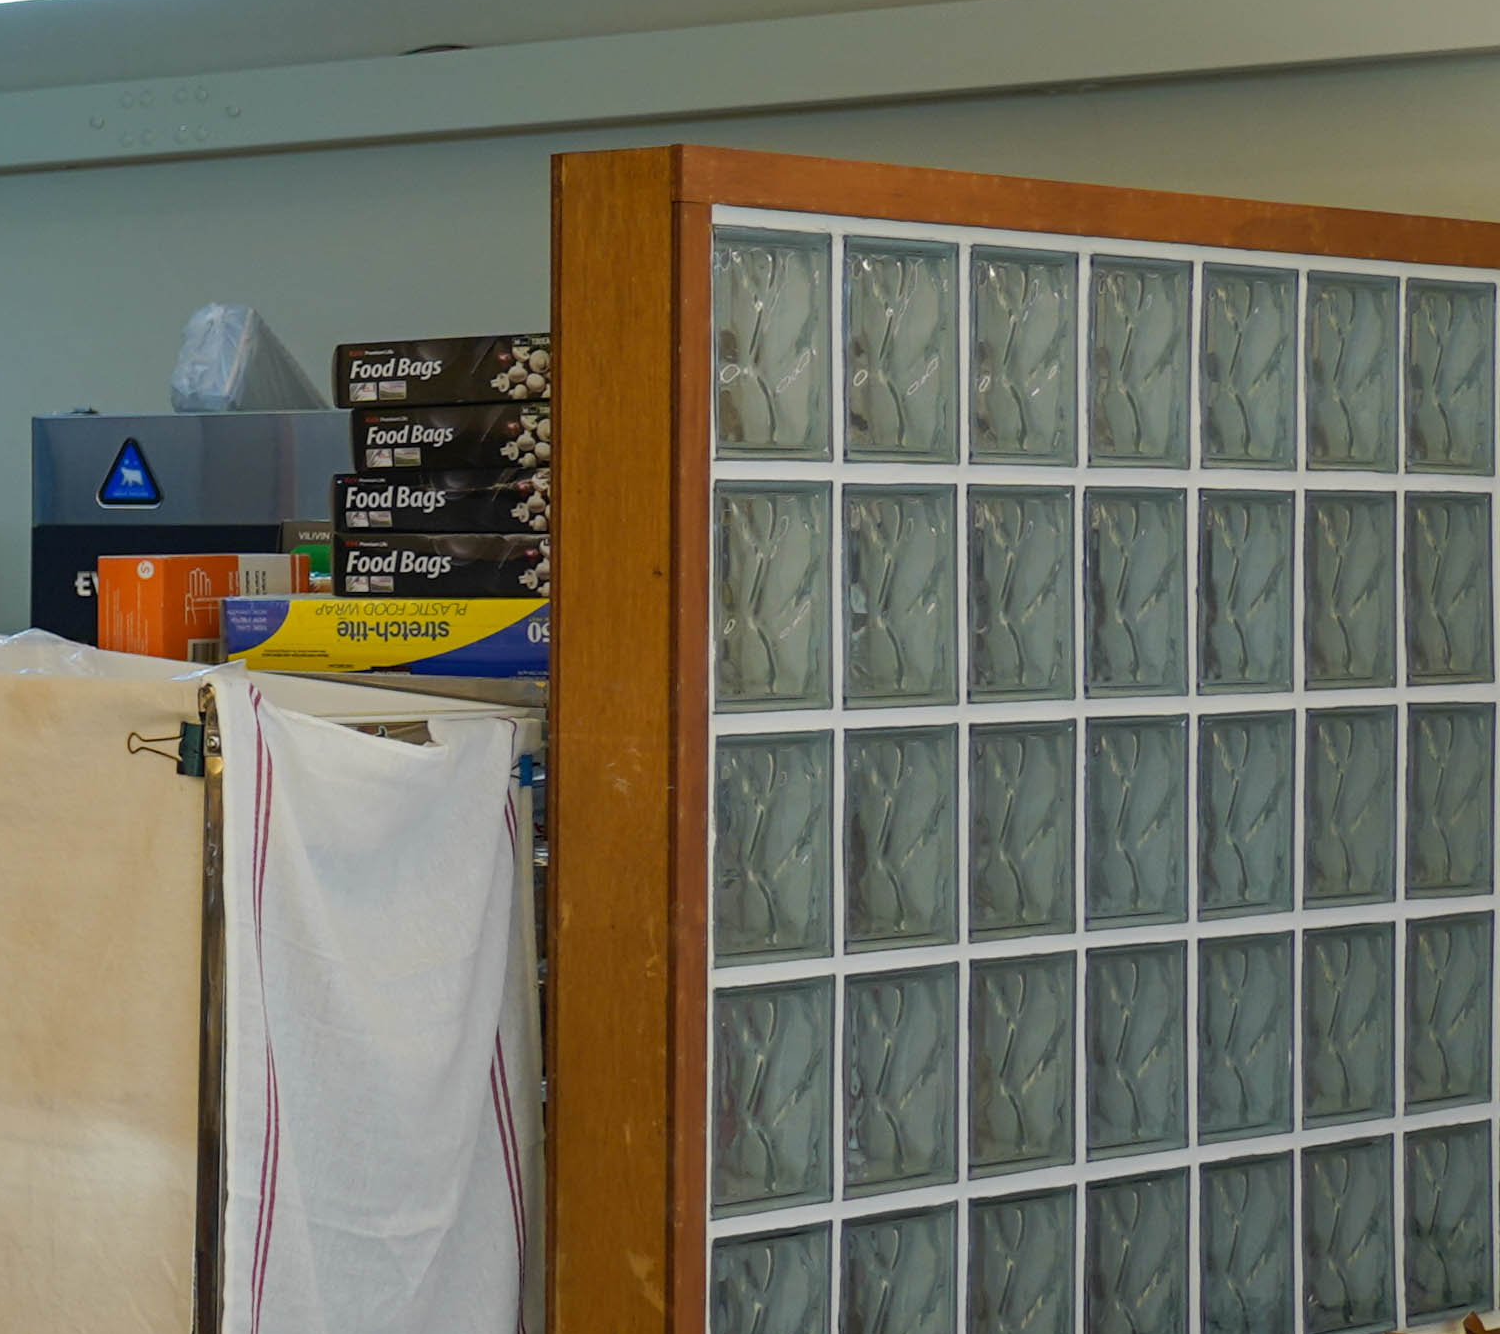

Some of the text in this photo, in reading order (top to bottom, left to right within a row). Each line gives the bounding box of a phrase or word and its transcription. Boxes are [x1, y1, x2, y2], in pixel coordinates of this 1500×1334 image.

[350, 357, 443, 381] Food Bags
[366, 424, 454, 448] Food Bags
[346, 485, 446, 514] Food Bags
[346, 550, 452, 579] Food Bags
[315, 603, 468, 617] PLASTIC FOOD WRAP
[336, 620, 450, 642] stretch-tite
